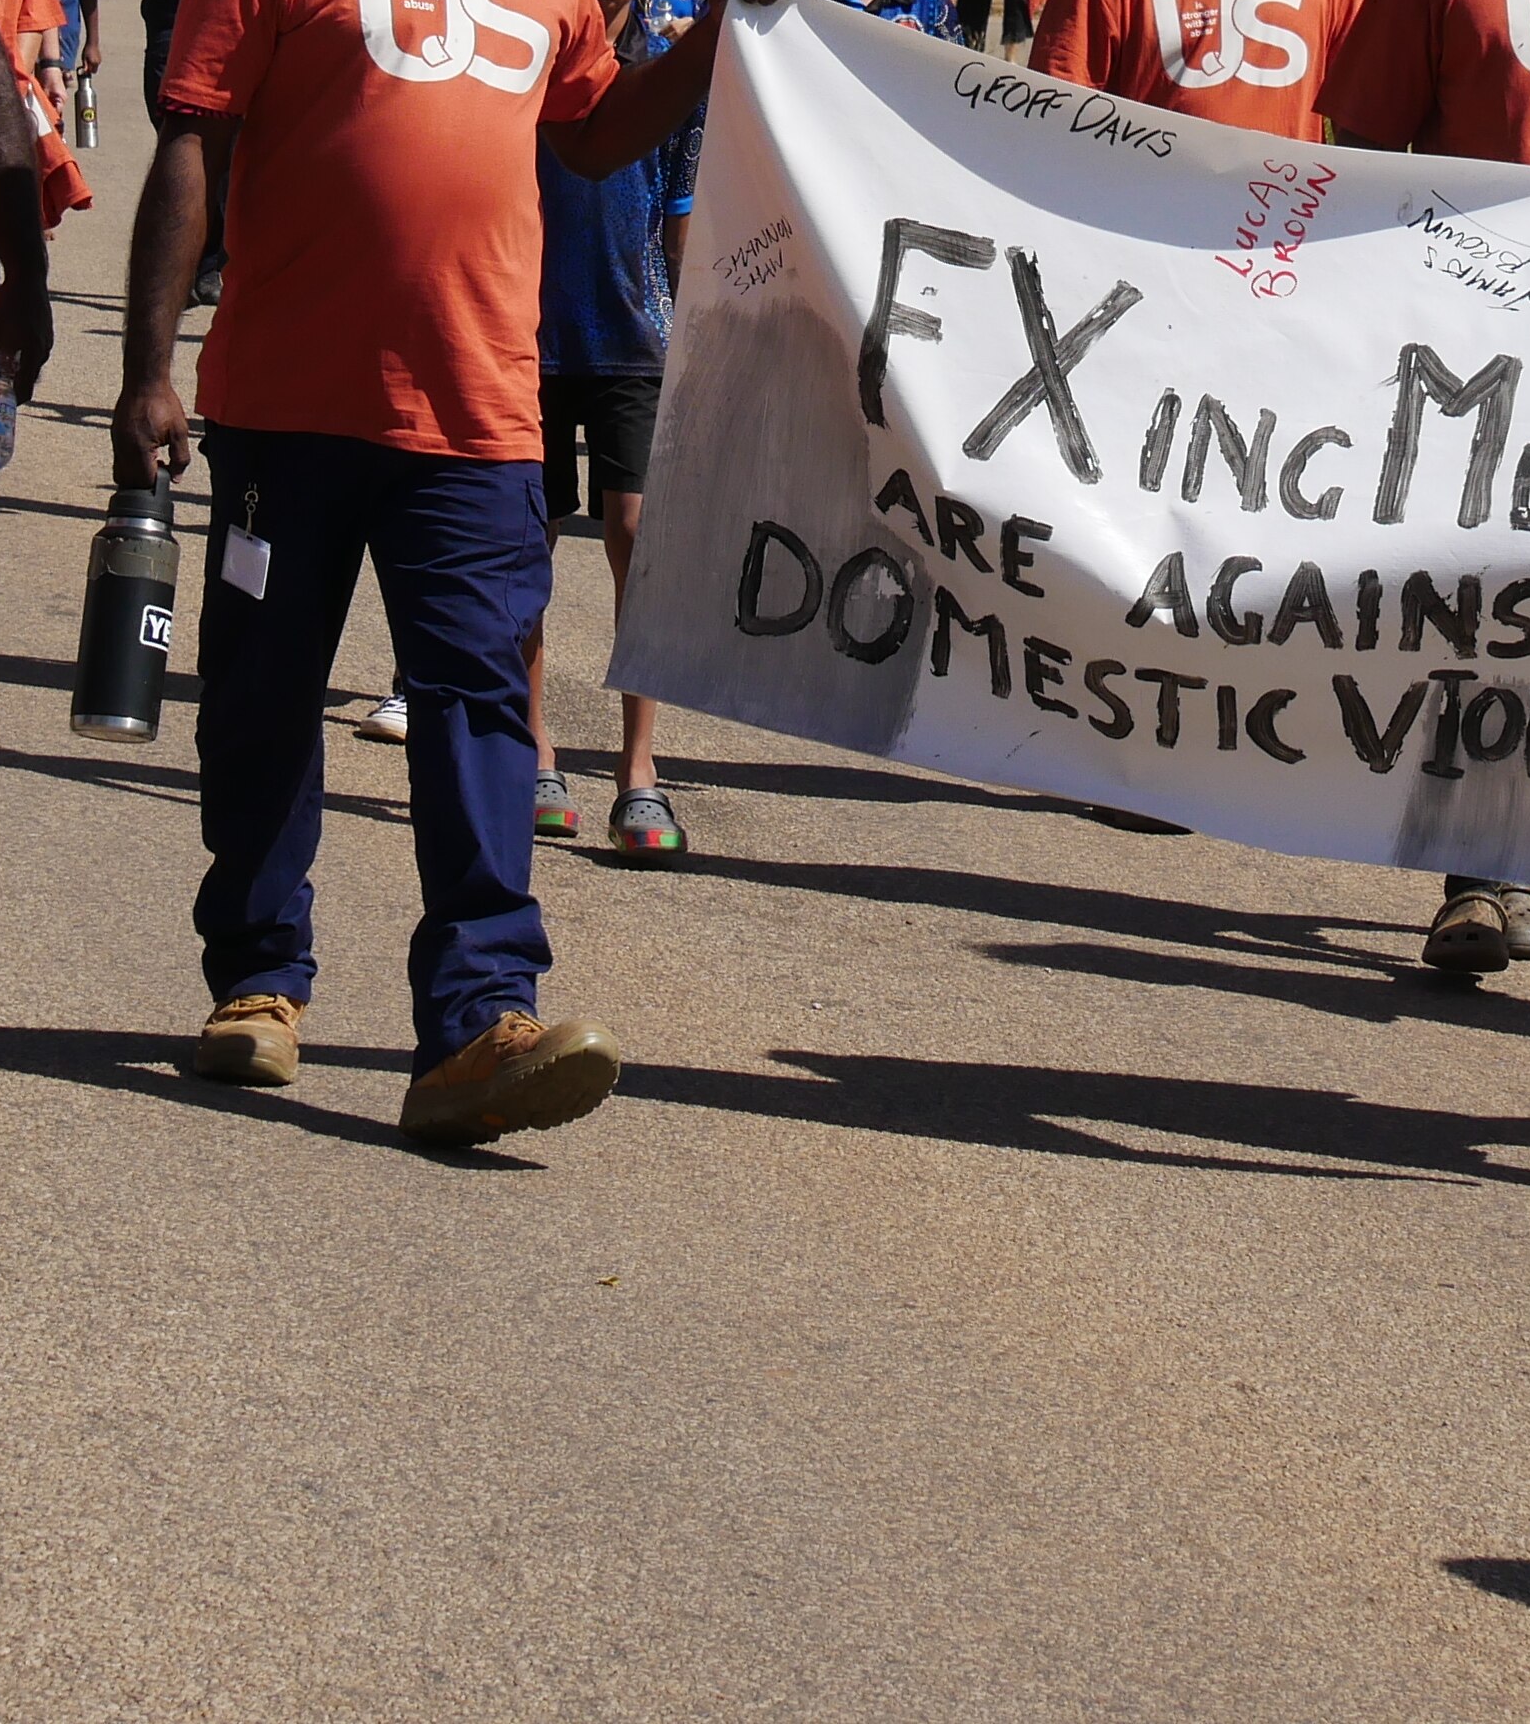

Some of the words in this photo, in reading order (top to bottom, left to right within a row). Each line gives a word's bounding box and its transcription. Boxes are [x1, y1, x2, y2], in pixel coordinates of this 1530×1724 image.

[404, 0, 435, 12] abuse
[954, 62, 1064, 118] GEOFF
[1069, 93, 1177, 158] DAVIS
[712, 215, 793, 280] SHANNON
[1215, 159, 1299, 280] LUCAS
[1251, 163, 1337, 299] BROWN
[873, 468, 1054, 598] ARE
[735, 519, 1308, 766] DOMESTIC
